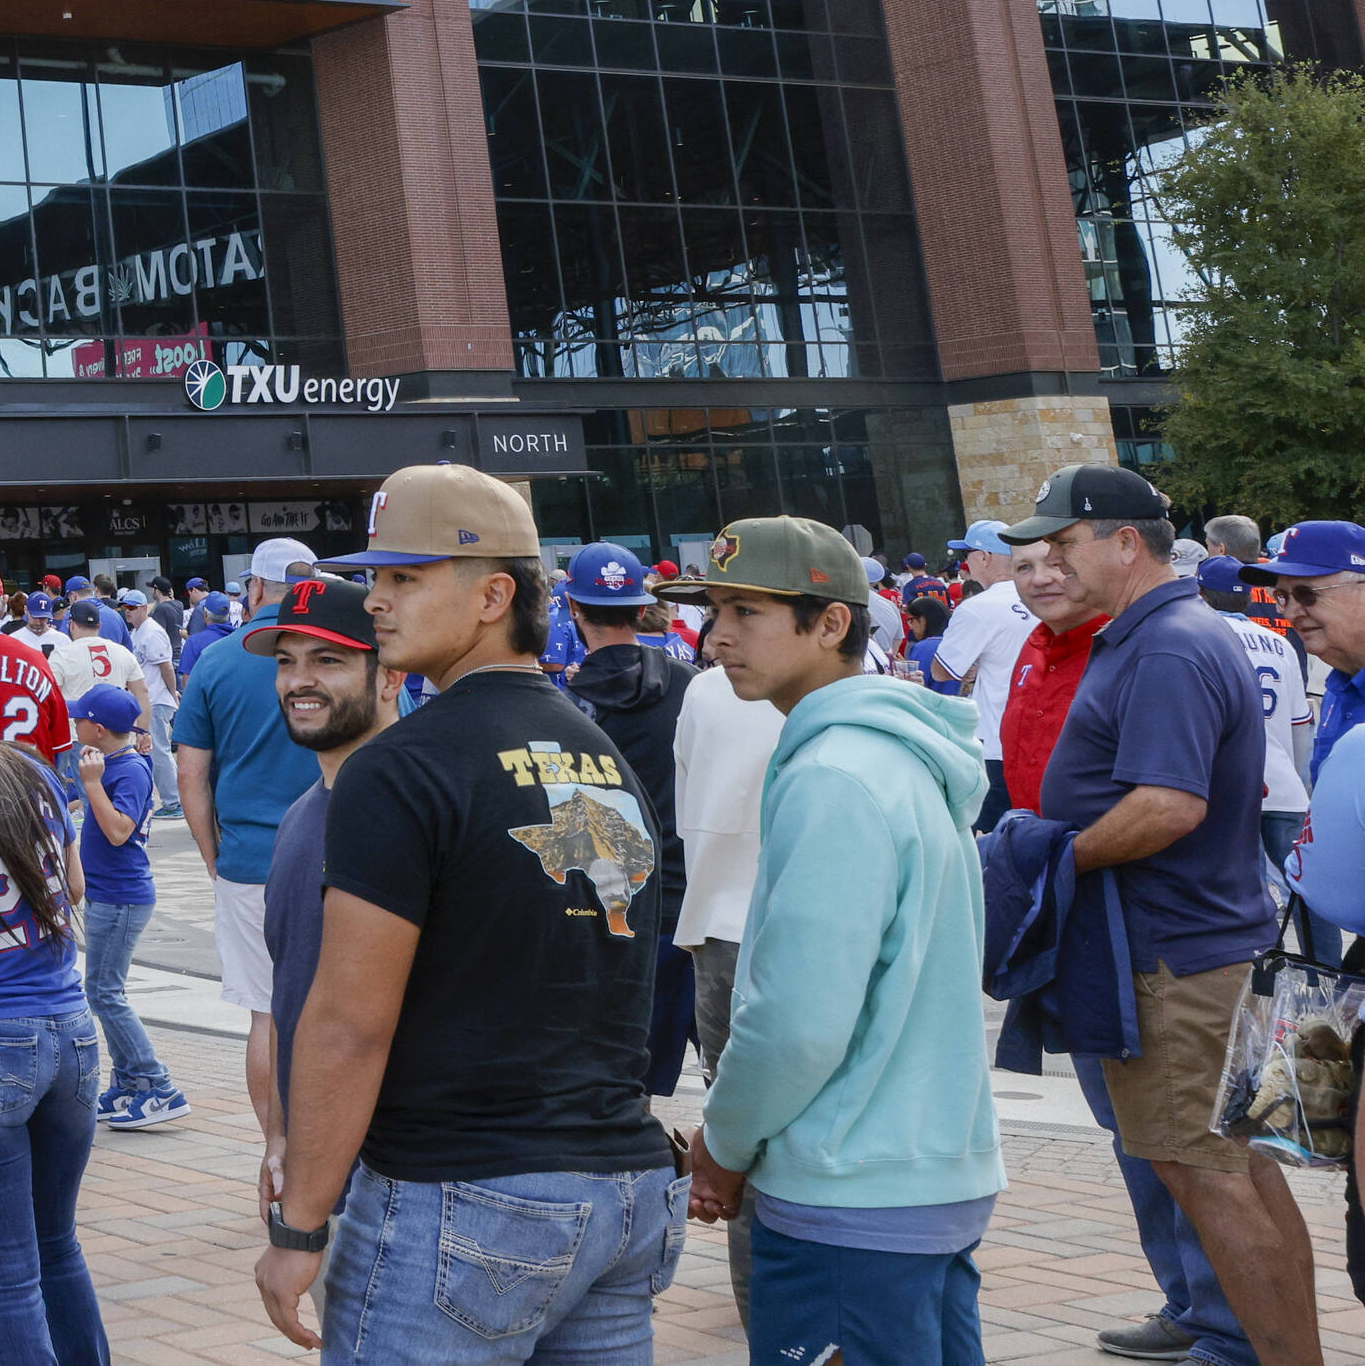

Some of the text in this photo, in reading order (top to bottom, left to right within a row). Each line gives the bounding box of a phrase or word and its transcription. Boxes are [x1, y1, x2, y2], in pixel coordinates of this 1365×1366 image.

[226, 364, 401, 412] TXU energy
[493, 434, 569, 453] NORTH
[109, 517, 140, 531] ALCS
[292, 580, 327, 614] T
[88, 644, 112, 678] 5
[497, 747, 623, 787] TEXAS
